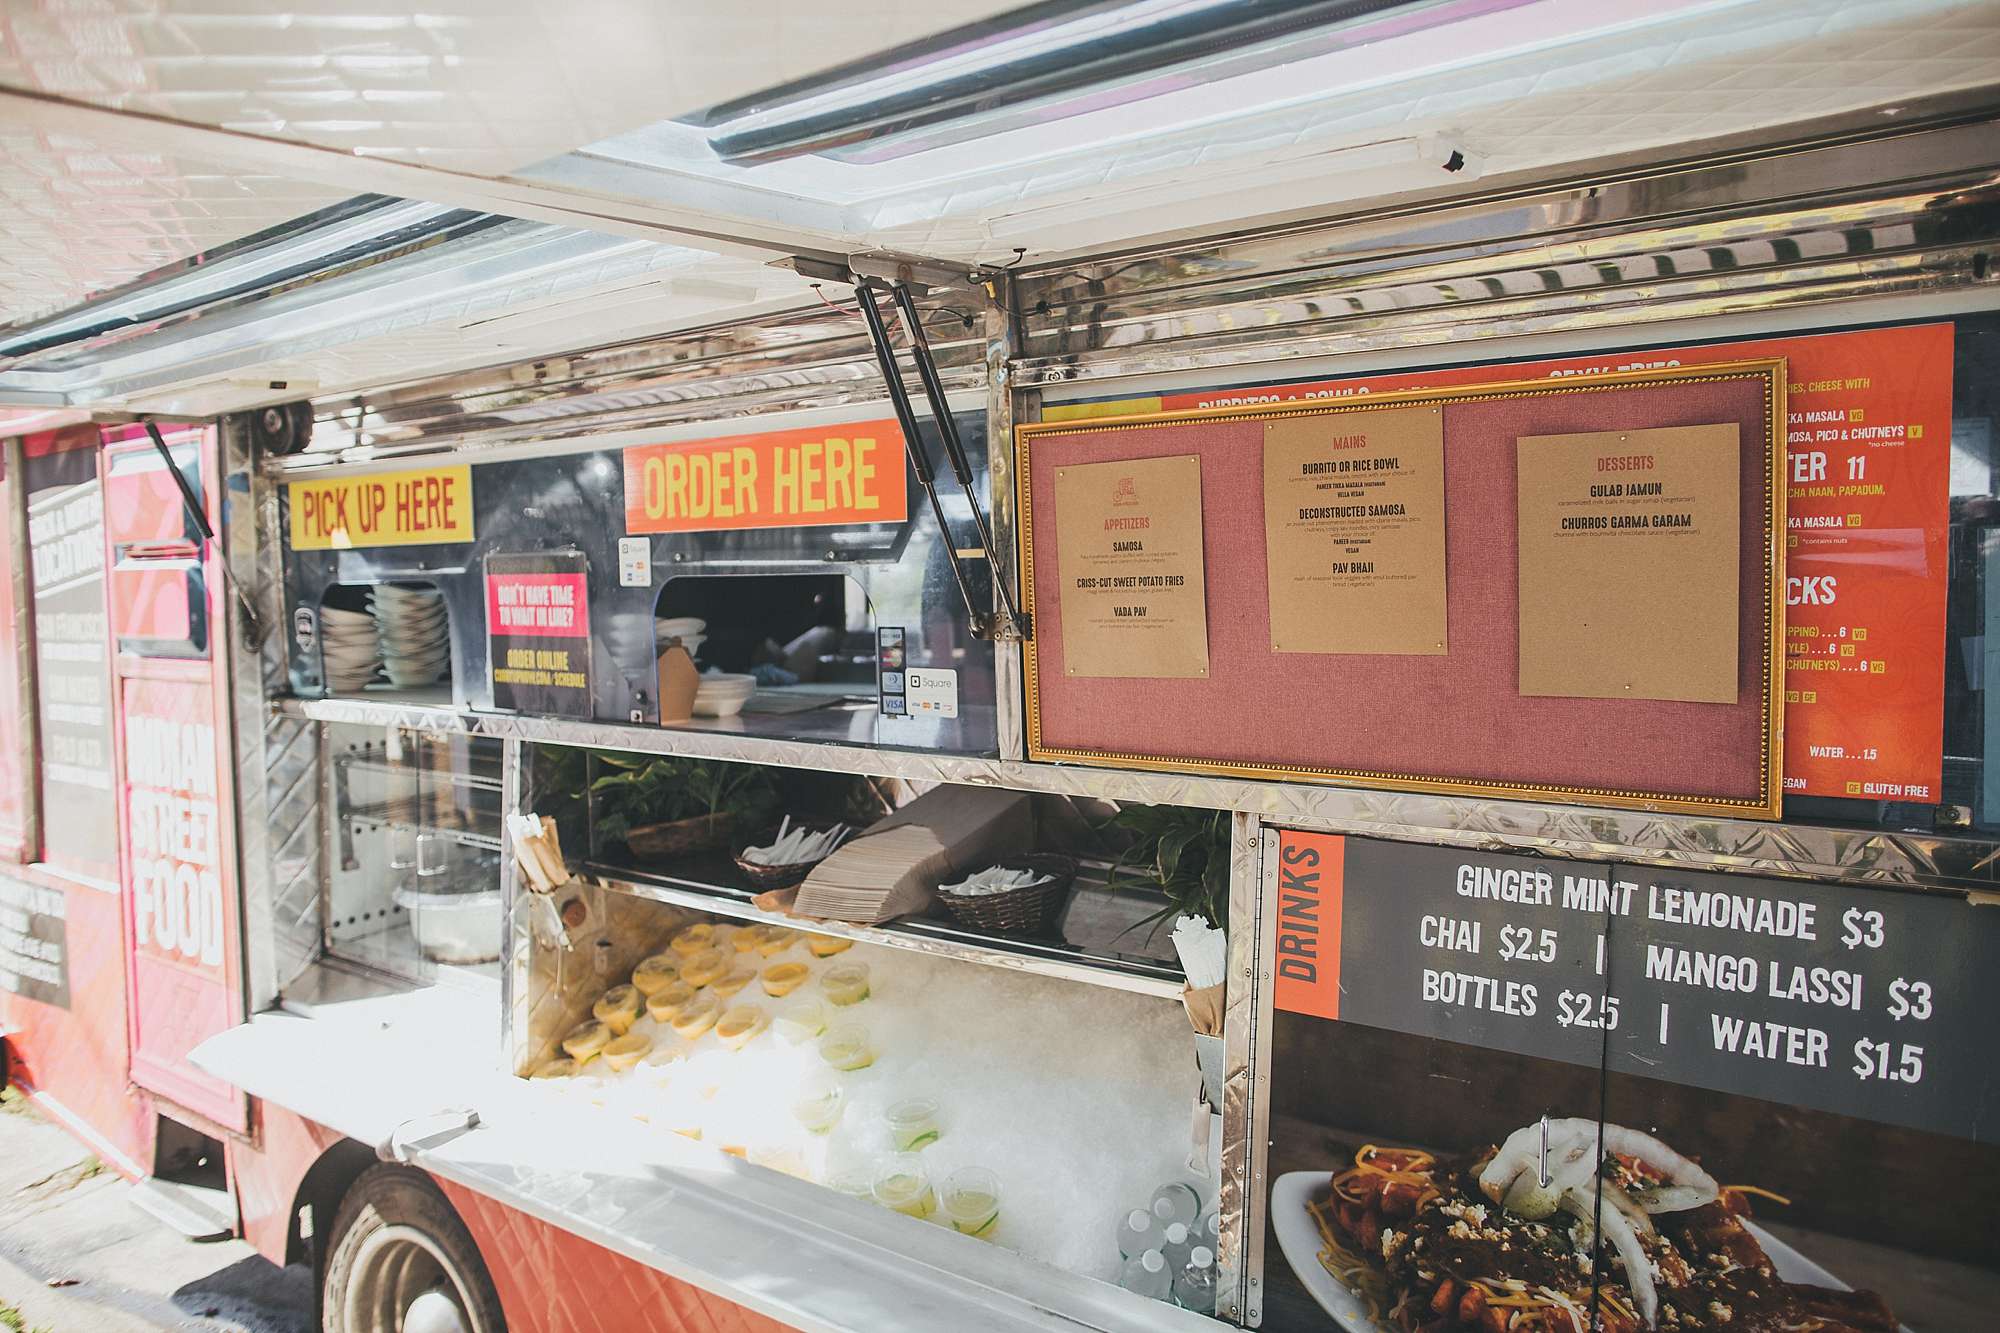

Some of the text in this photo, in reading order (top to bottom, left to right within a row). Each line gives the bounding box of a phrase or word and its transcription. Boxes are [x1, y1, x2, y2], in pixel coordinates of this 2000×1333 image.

[1788, 378, 1870, 395] IES, CHEESE WITH
[1788, 413, 1803, 424] KA
[1806, 410, 1845, 423] MASALA
[1816, 429, 1838, 441] PICO
[1841, 430, 1849, 440] &
[1851, 425, 1904, 439] CHUTNEYS
[1333, 435, 1367, 450] MAINS
[1302, 457, 1400, 475] BURRITO OR RICE BOWL
[1598, 455, 1654, 472] DESSERTS
[1847, 456, 1866, 480] 11
[643, 438, 879, 521] ORDER HERE
[1590, 482, 1662, 497] GULAB JAMUN
[1808, 486, 1836, 497] NAAN,
[1839, 484, 1886, 496] PAPADUM,
[303, 477, 457, 537] PICK UP HERE
[1300, 504, 1406, 520] DECONSTRUCTED SAMOSA
[1104, 517, 1150, 530] APPETIZERS
[1562, 514, 1691, 530] CHURROS GARMA GARAM
[1803, 516, 1843, 528] MASALA
[1113, 541, 1143, 552] SAMOSA
[1333, 562, 1374, 574] PAV BHAJI
[1077, 575, 1184, 588] CRISS-CUT SWEET POTATO FRIES
[498, 584, 575, 606] DON'T HAVE TIME
[1786, 576, 1837, 605] CKS
[499, 607, 574, 627] TO WAIT IN LINE?
[1113, 606, 1147, 617] VADA PAV
[1786, 643, 1809, 654] YLE)
[507, 648, 569, 671] ORDER ONLINE
[1787, 659, 1840, 672] CHUTNEYS)
[922, 677, 952, 688] Square
[886, 700, 904, 708] VISA
[1810, 746, 1843, 758] WATER
[1864, 783, 1902, 796] GLUTEN
[1905, 785, 1929, 798] FREE
[131, 790, 218, 867] STREET
[134, 858, 223, 966] FOOD
[1279, 844, 1320, 984] DRINKS
[1456, 864, 1885, 950] GINGER MINT LEMONADE $3
[1420, 915, 1481, 954] CHAI
[1498, 924, 1558, 963] $2.5
[1645, 945, 1758, 993] MANGO
[1768, 961, 1863, 1011] LASSI
[1887, 977, 1933, 1021] $3
[1422, 968, 1538, 1017] BOTTLES
[1556, 989, 1620, 1031] $2.5
[1711, 1013, 1829, 1068] WATER
[1852, 1037, 1924, 1084] $1.5
